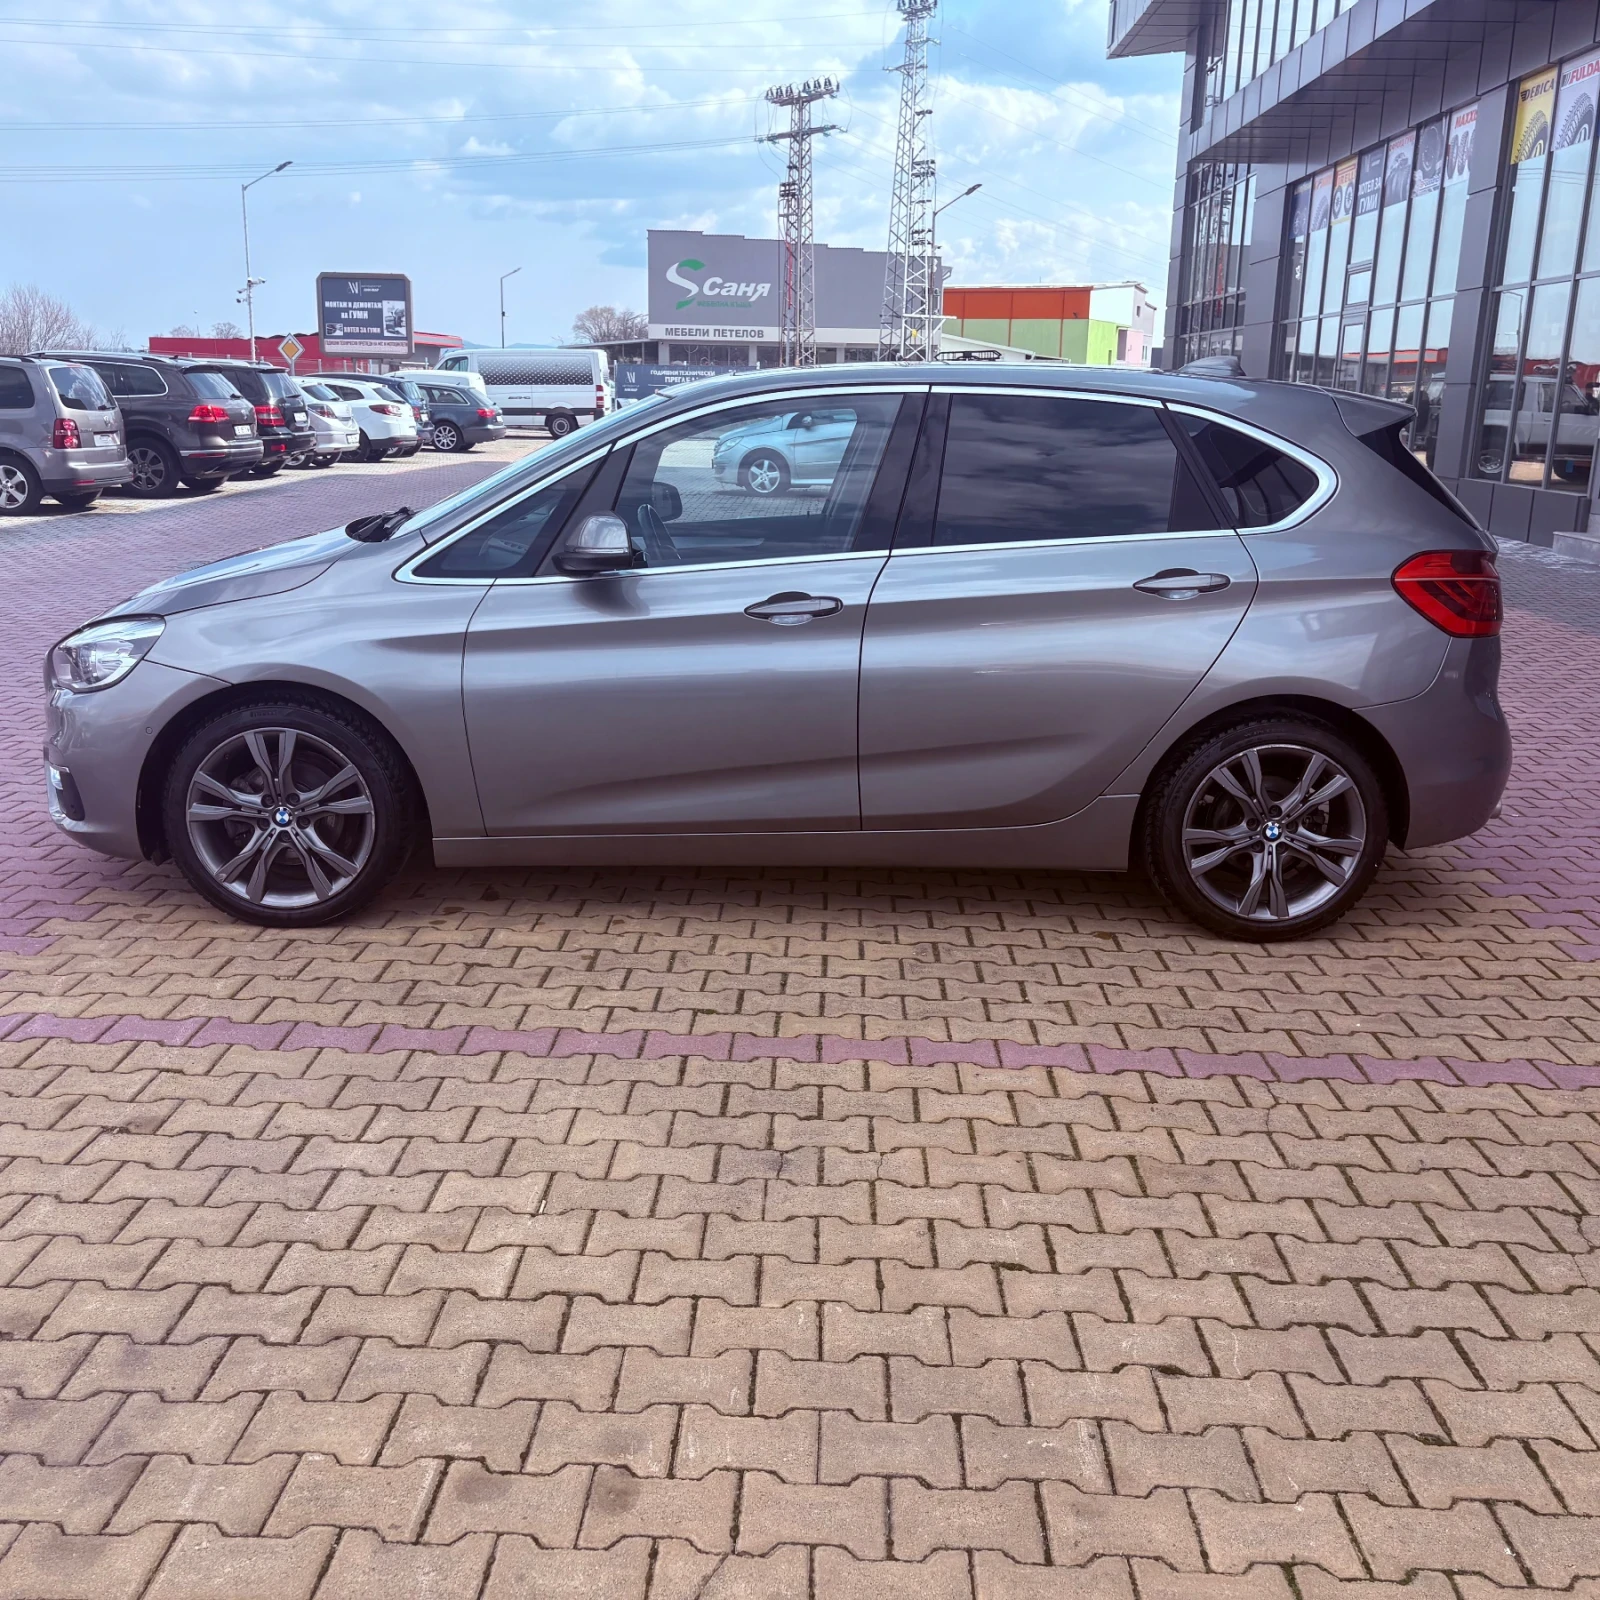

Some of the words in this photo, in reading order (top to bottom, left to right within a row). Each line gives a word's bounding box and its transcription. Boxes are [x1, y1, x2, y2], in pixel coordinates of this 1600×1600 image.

[1569, 60, 1600, 85] FULDA
[1359, 193, 1379, 214] ГУМИ
[702, 276, 771, 302] Саня
[349, 310, 369, 319] ГУМИ
[665, 327, 710, 337] МЕБЕЛИ
[713, 328, 765, 338] ПЕТЕЛОВ
